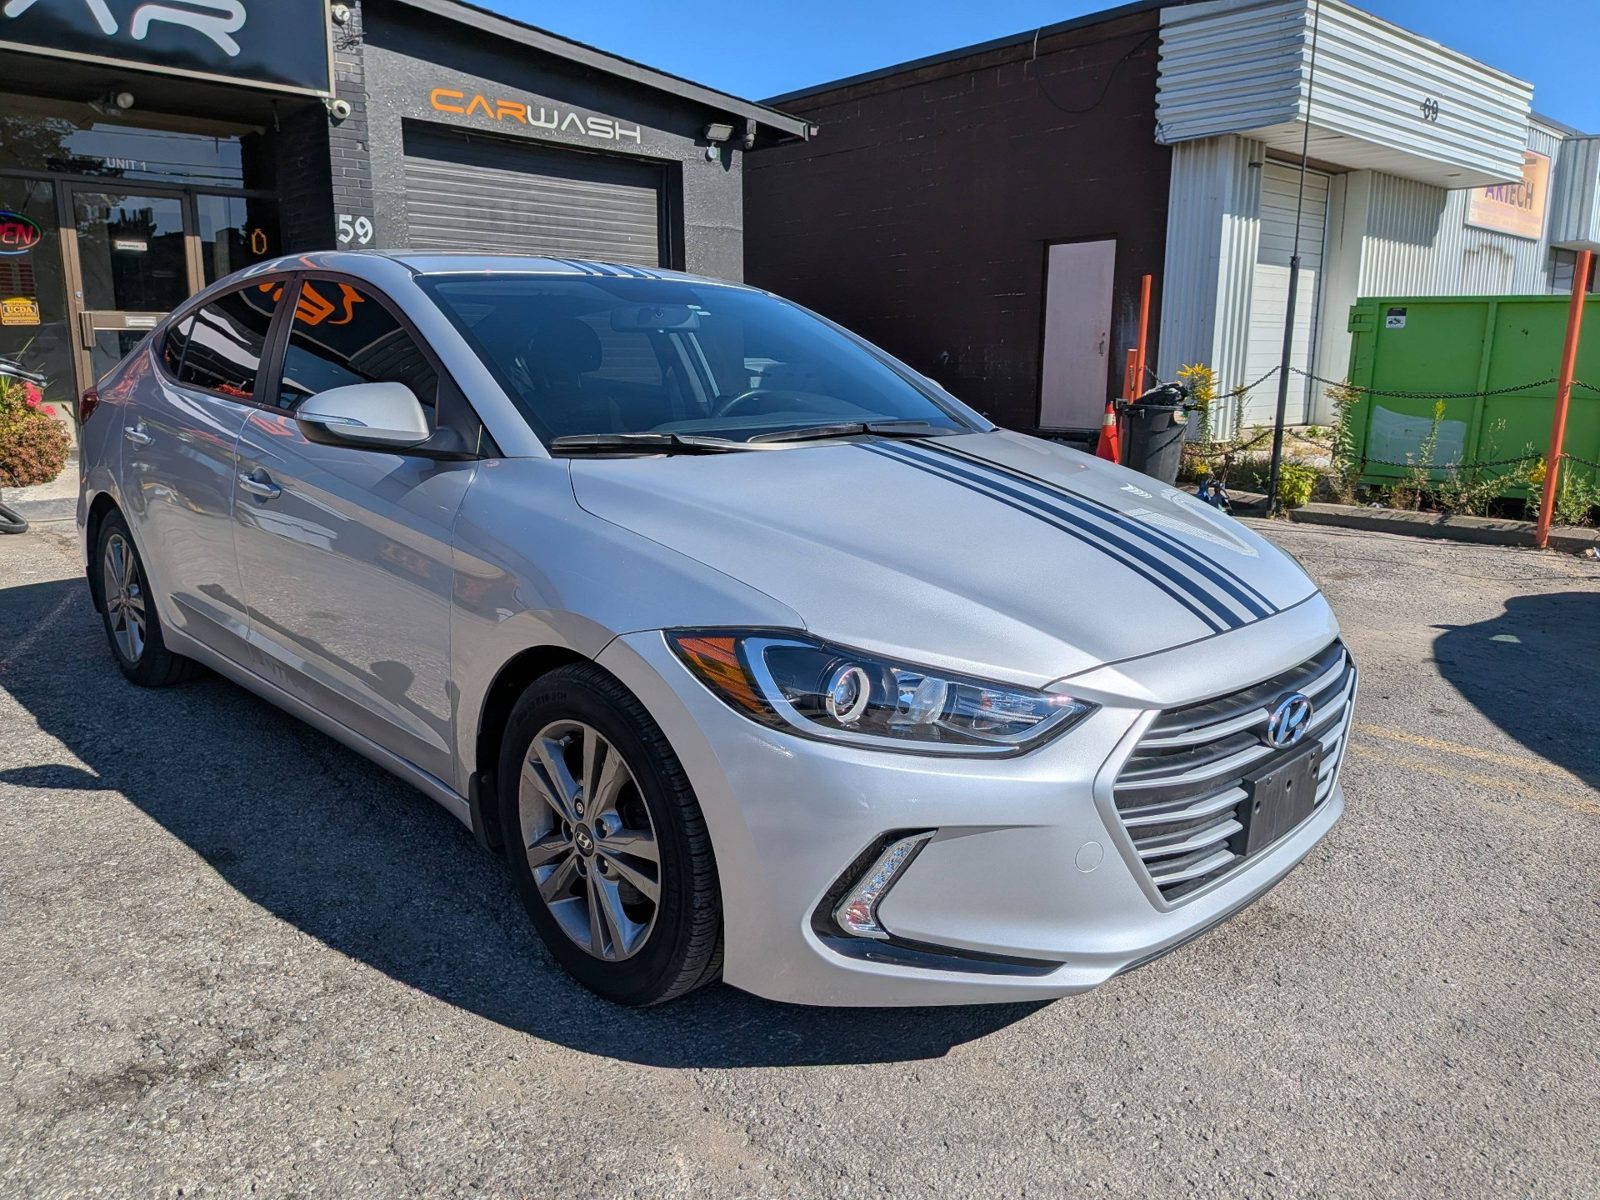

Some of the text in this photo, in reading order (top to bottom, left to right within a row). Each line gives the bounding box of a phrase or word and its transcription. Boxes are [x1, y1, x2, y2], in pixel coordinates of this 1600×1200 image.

[430, 88, 642, 144] CARWASH
[1423, 97, 1438, 122] 69
[106, 157, 146, 171] UNIT 1
[0, 223, 34, 245] EN
[338, 214, 373, 245] 59
